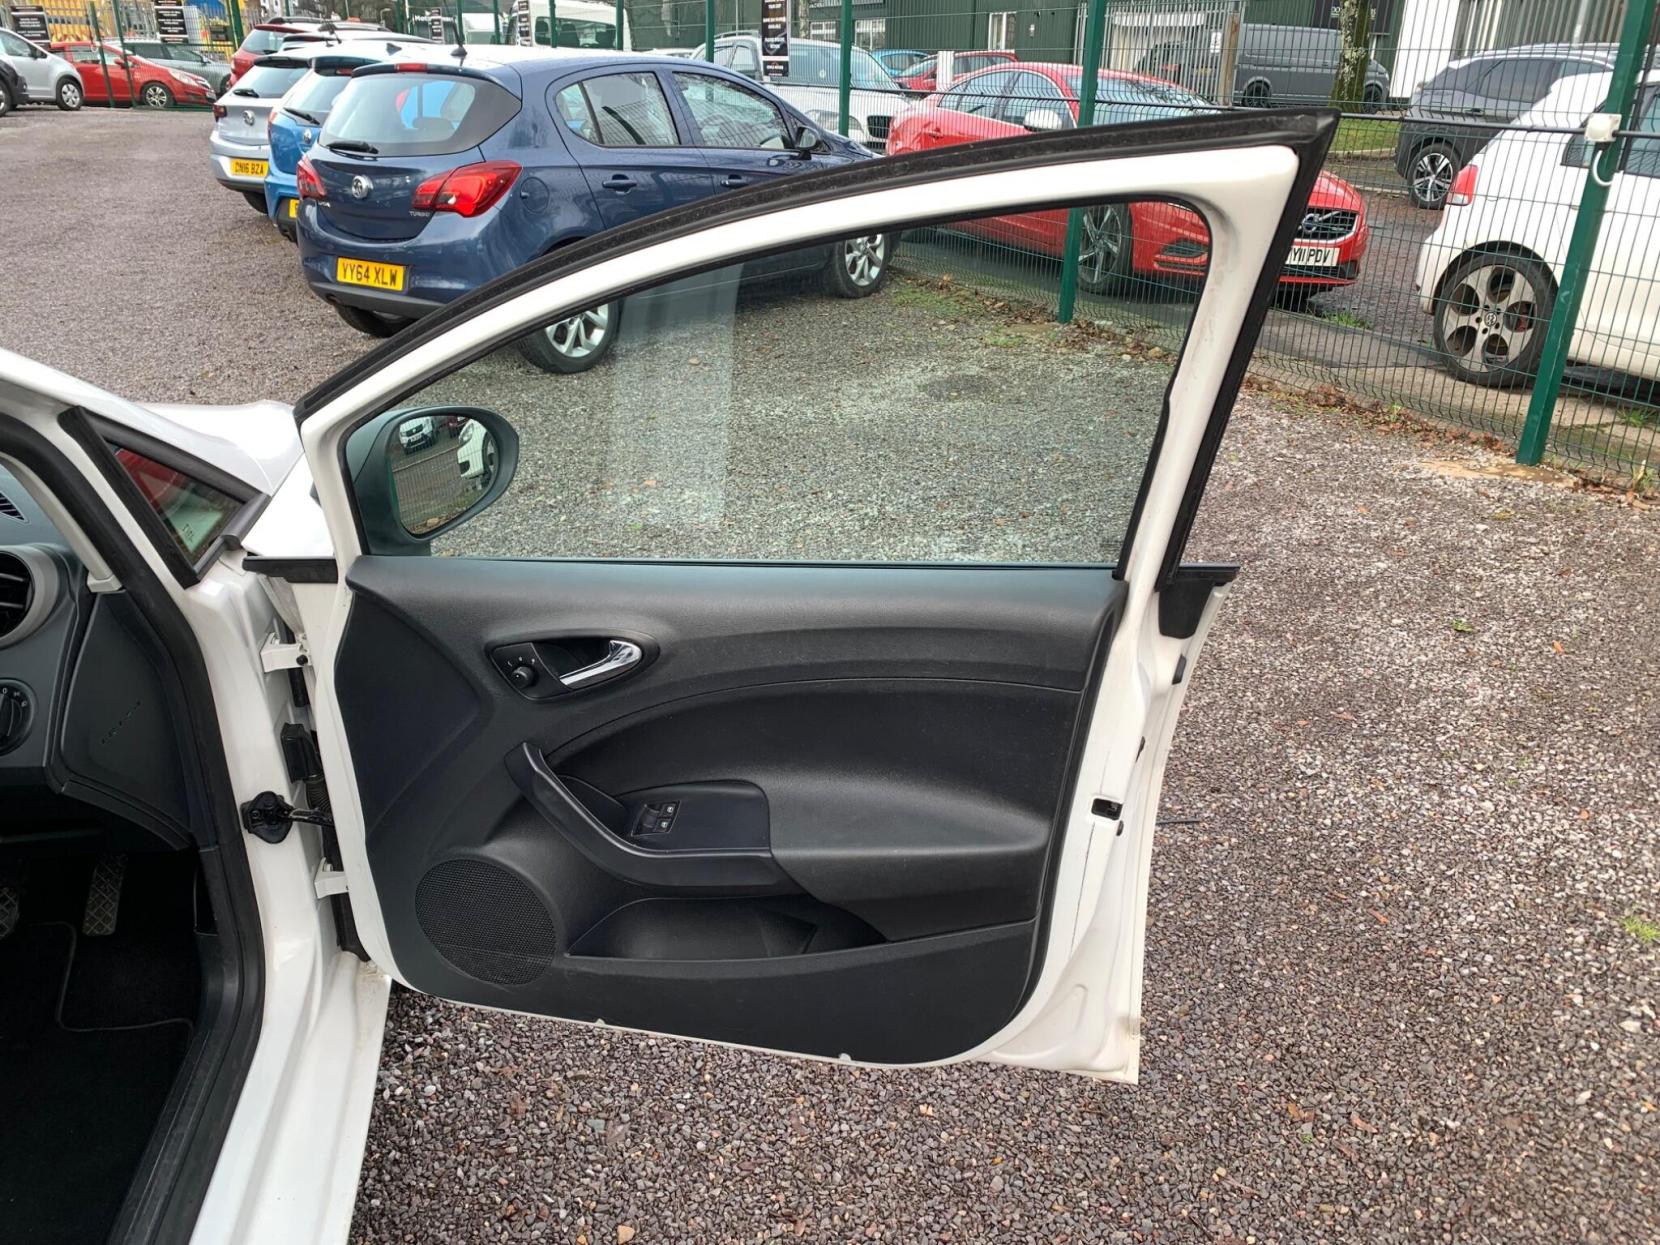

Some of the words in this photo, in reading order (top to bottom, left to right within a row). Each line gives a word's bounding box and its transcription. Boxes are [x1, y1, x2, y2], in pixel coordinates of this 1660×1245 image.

[1306, 248, 1330, 263] PDV
[342, 262, 370, 283] YY64
[373, 266, 398, 287] XLW
